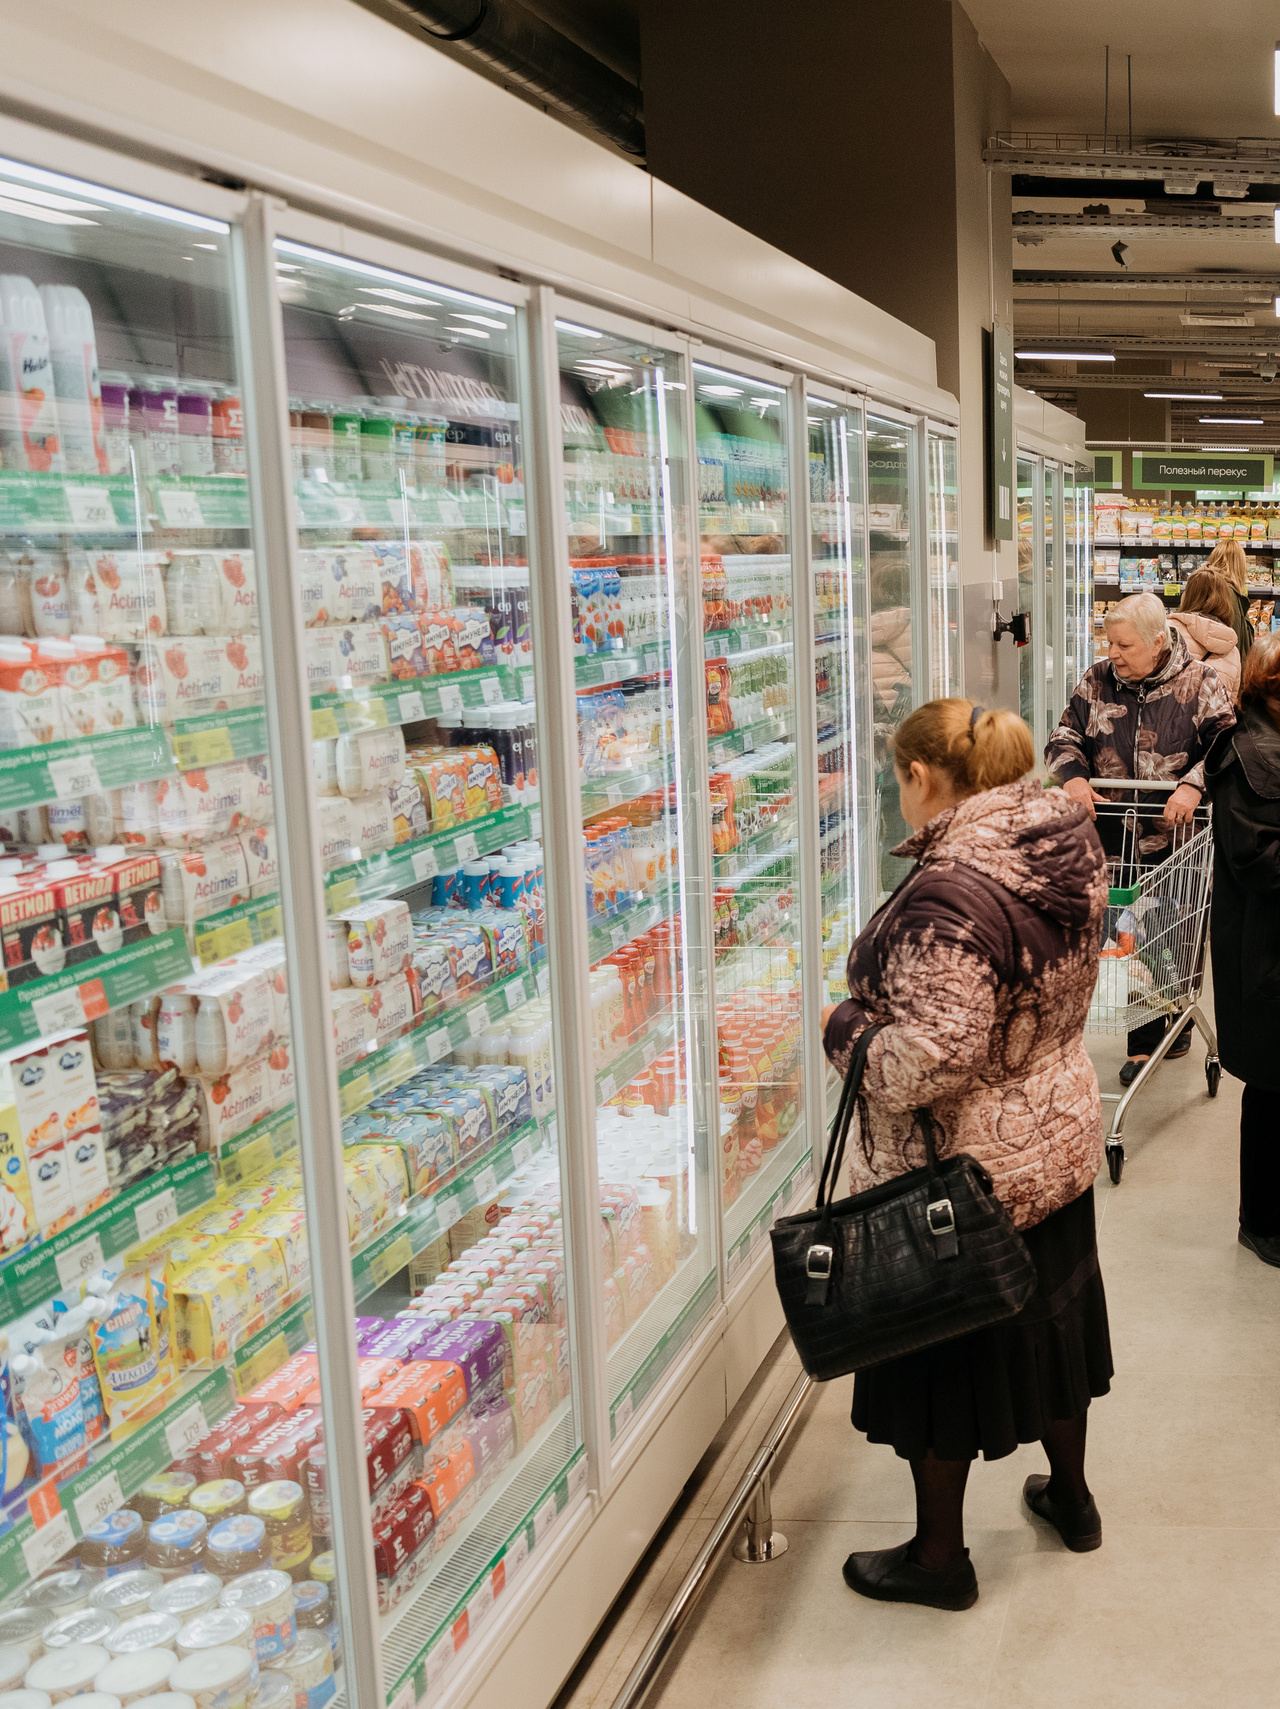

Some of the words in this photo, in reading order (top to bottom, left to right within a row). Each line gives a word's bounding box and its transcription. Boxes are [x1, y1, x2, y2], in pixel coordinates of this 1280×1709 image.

[1159, 465, 1206, 477] Полезный
[1207, 467, 1248, 478] перекус
[339, 581, 375, 598] Actimel
[392, 632, 421, 653] ИМУНЕЛЕ
[459, 625, 489, 643] ИМУНЕЛЕ
[347, 655, 380, 673] Actimel
[368, 748, 400, 770] Actimel
[197, 787, 242, 814] Actimel
[361, 820, 389, 840] Actimel
[64, 872, 114, 908] ПЕТМОЛ
[194, 869, 239, 900] Actimel
[380, 934, 409, 961] Actimel
[457, 947, 485, 972] ИМУНЕЛЕ
[422, 965, 449, 992] ИМУНЕЛЕ
[376, 1003, 407, 1032] Actimel
[220, 1086, 263, 1123] Actimel
[254, 1275, 284, 1305] Actimel
[367, 1318, 417, 1356] IMMUNO
[427, 1320, 475, 1358] IMMUNO
[251, 1356, 308, 1398] IMMUNO
[381, 1362, 432, 1405] IMMUNO
[248, 1408, 314, 1454] IMMUNO
